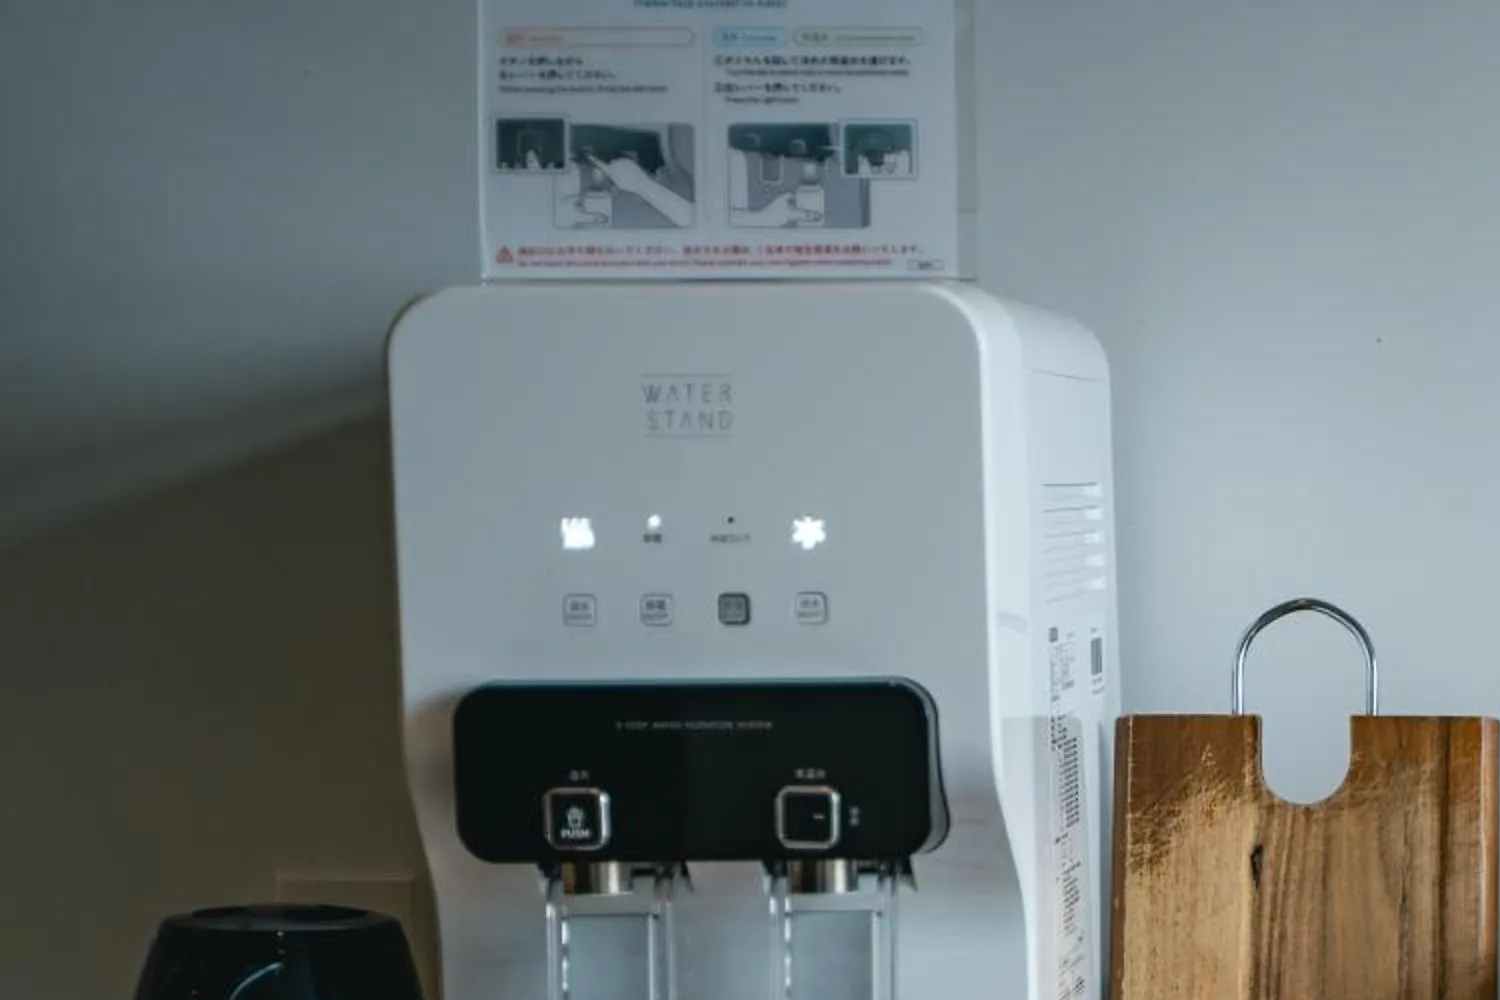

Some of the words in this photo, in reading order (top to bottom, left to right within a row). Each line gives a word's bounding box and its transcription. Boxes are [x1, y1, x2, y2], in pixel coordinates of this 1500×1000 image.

[642, 383, 733, 404] WATER
[645, 408, 734, 431] STAND
[561, 828, 590, 839] PUSH
